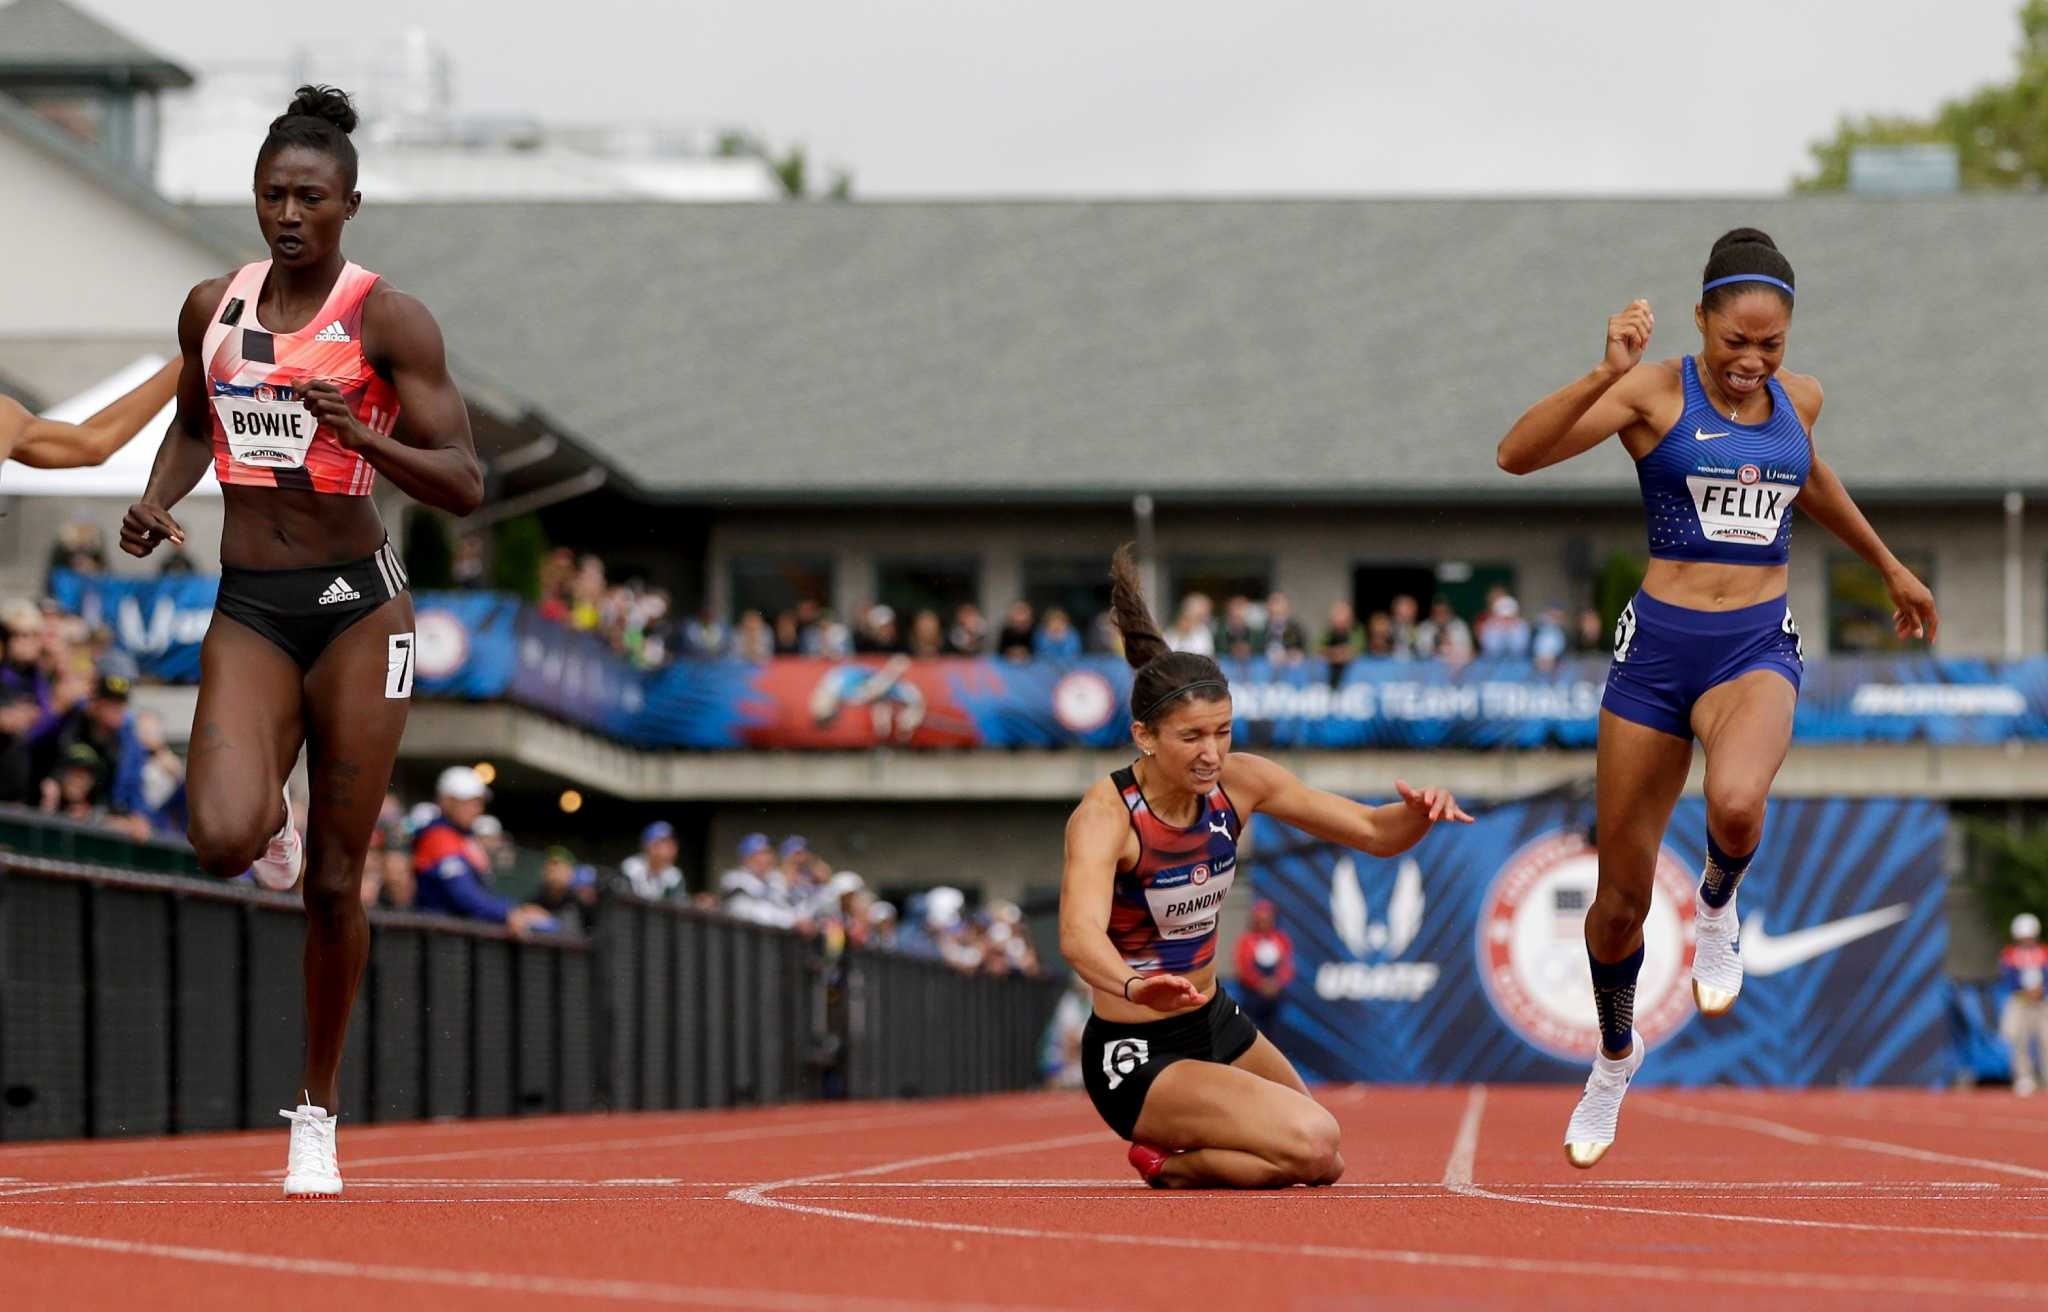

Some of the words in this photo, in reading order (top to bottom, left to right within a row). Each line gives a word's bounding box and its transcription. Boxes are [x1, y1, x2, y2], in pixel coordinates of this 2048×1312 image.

[315, 333, 350, 343] adidas
[232, 411, 303, 439] BOWIE
[1701, 486, 1781, 521] FELIX
[319, 591, 360, 605] adidas
[396, 639, 410, 692] 7
[1111, 1041, 1141, 1080] 6
